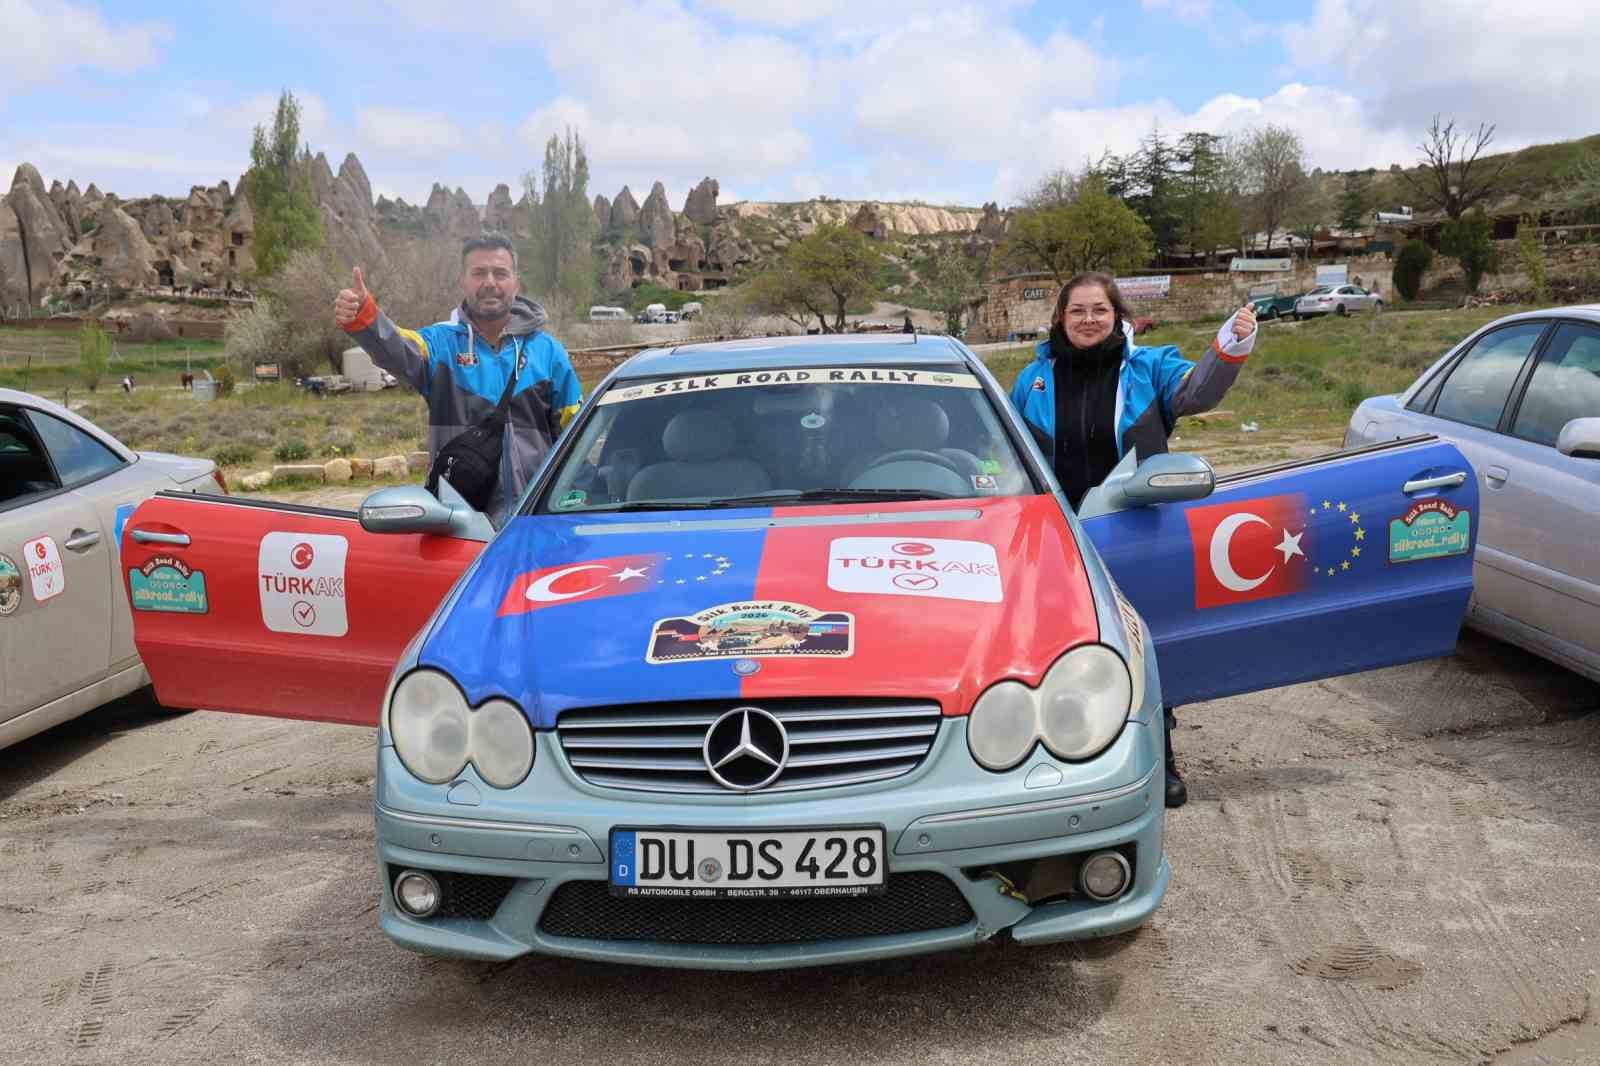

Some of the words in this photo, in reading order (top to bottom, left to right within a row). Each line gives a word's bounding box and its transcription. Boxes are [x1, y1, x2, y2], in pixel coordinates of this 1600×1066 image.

[654, 377, 719, 394] SILK
[736, 371, 811, 385] ROAD
[829, 370, 919, 382] RALLY
[835, 556, 998, 576] TÜRKAK
[261, 571, 344, 598] TÜRKAK
[697, 608, 726, 622] Silk
[731, 603, 773, 612] Road
[781, 605, 813, 619] Rally
[740, 611, 769, 619] 2026
[640, 838, 694, 880] DU
[727, 838, 784, 881] DS
[795, 837, 876, 879] 428
[619, 864, 628, 877] D
[640, 888, 690, 896] AUTOMOBILE
[814, 886, 868, 895] OBERHAUSEN
